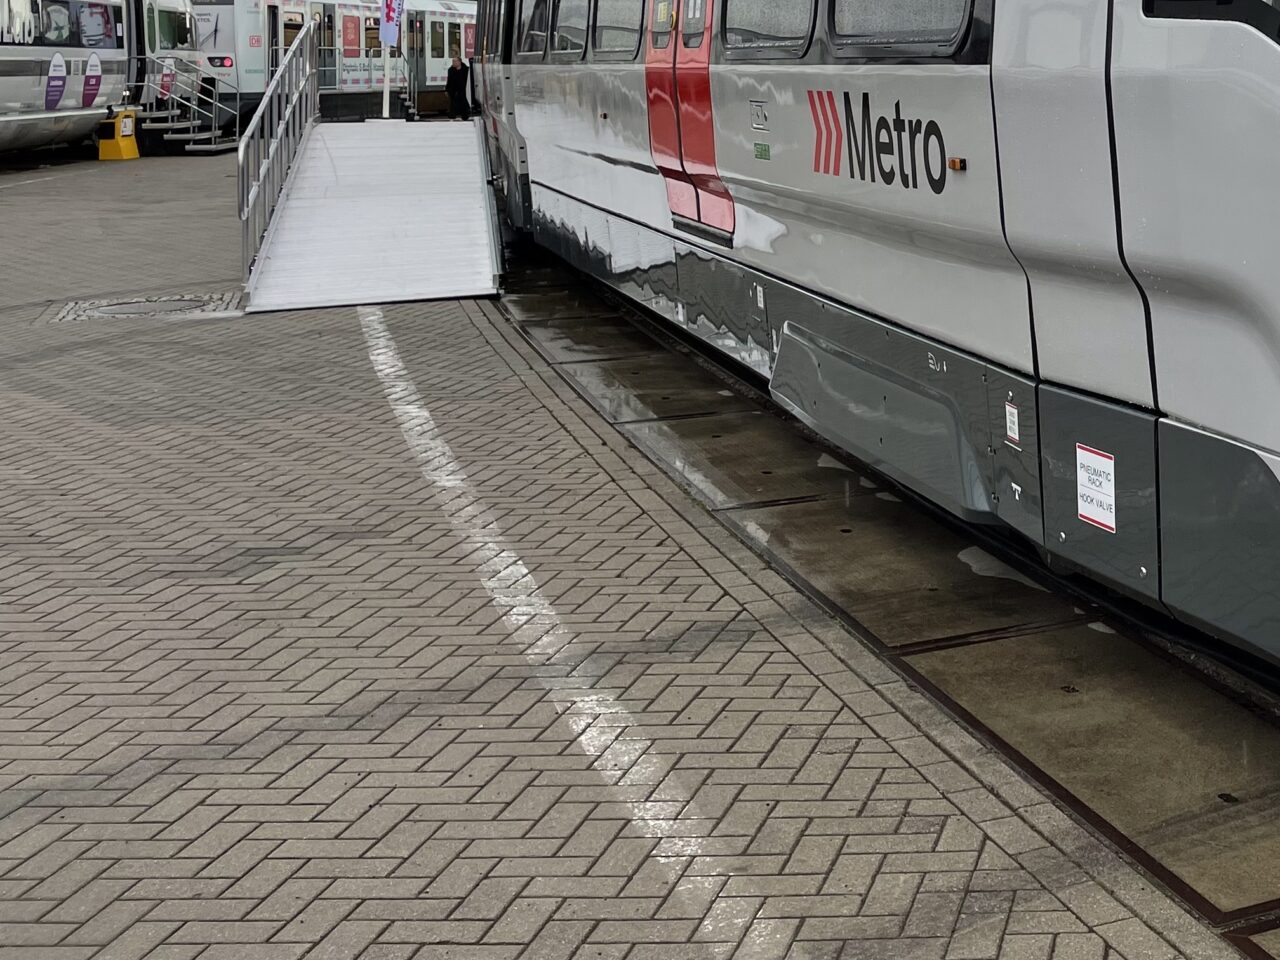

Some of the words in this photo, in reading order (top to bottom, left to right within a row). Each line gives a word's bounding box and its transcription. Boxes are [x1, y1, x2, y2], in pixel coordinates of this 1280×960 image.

[843, 91, 947, 195] Metro
[1080, 462, 1112, 482] PNEUMATIC
[1079, 493, 1095, 506] HOOK
[1095, 499, 1114, 514] VALVE
